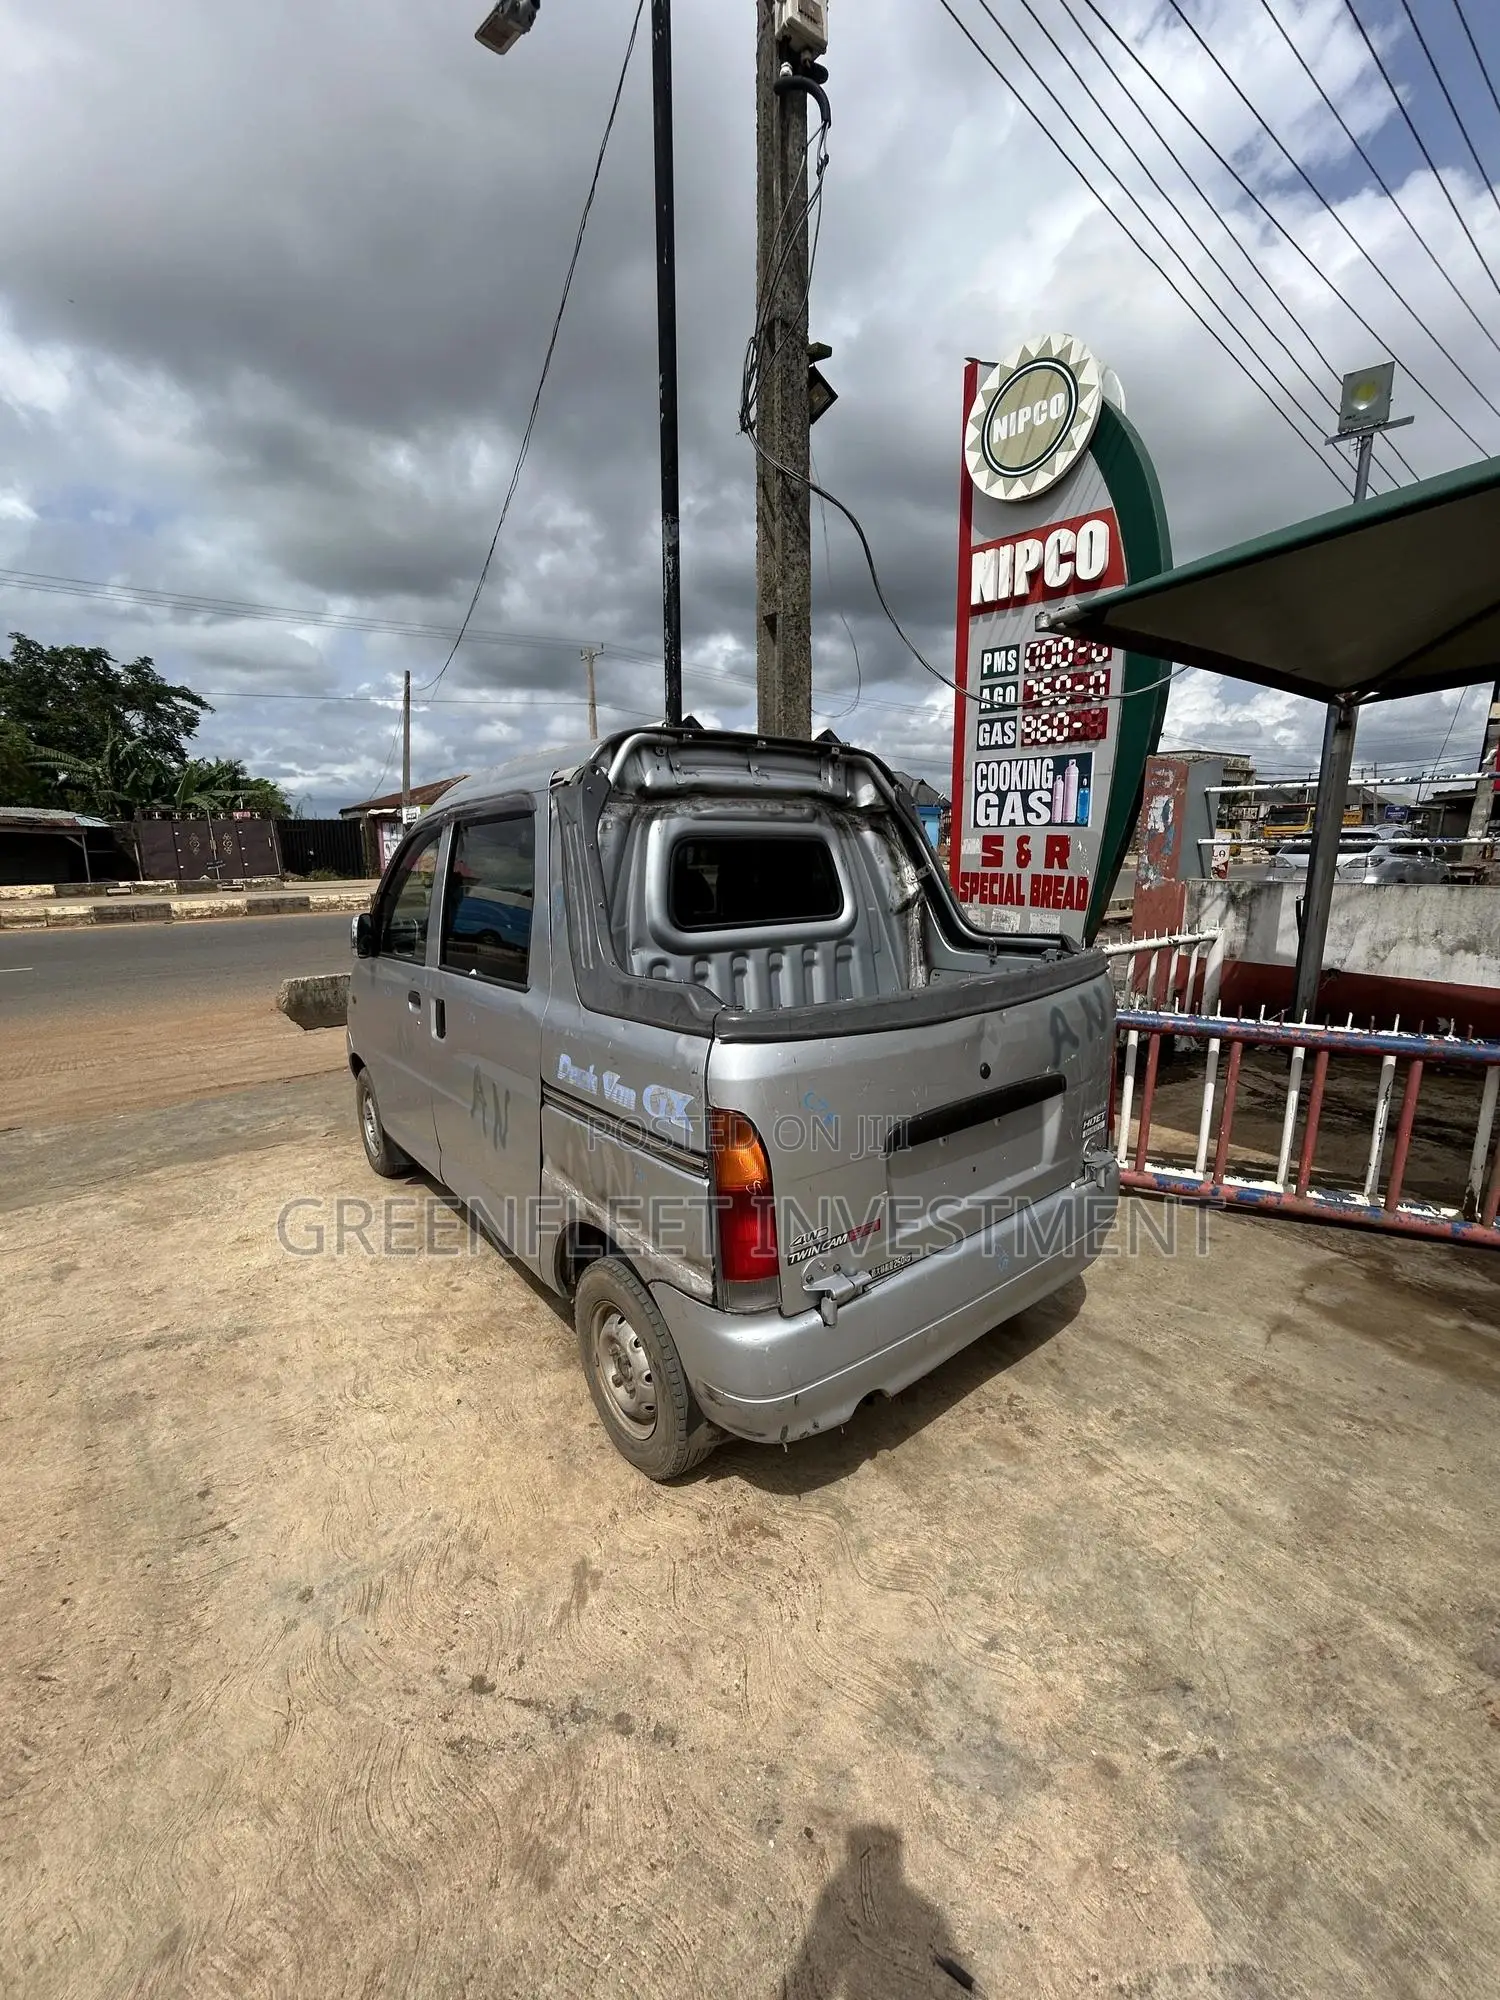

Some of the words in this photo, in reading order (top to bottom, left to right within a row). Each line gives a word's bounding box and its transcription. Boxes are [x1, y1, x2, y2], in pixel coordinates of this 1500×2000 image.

[992, 392, 1066, 444] NIPCO
[970, 519, 1110, 606] NIPCO
[982, 649, 1017, 674] PMS
[980, 685, 1016, 709] AGO
[978, 721, 1016, 747] GAS
[976, 757, 1054, 793] COOKING
[976, 789, 1052, 827] GAS
[981, 834, 1005, 868] S
[1044, 834, 1071, 870] R
[959, 871, 1026, 907] SPECIAL
[1029, 873, 1090, 912] BREAD
[789, 1243, 821, 1264] TWIN
[821, 1232, 848, 1251] CAM
